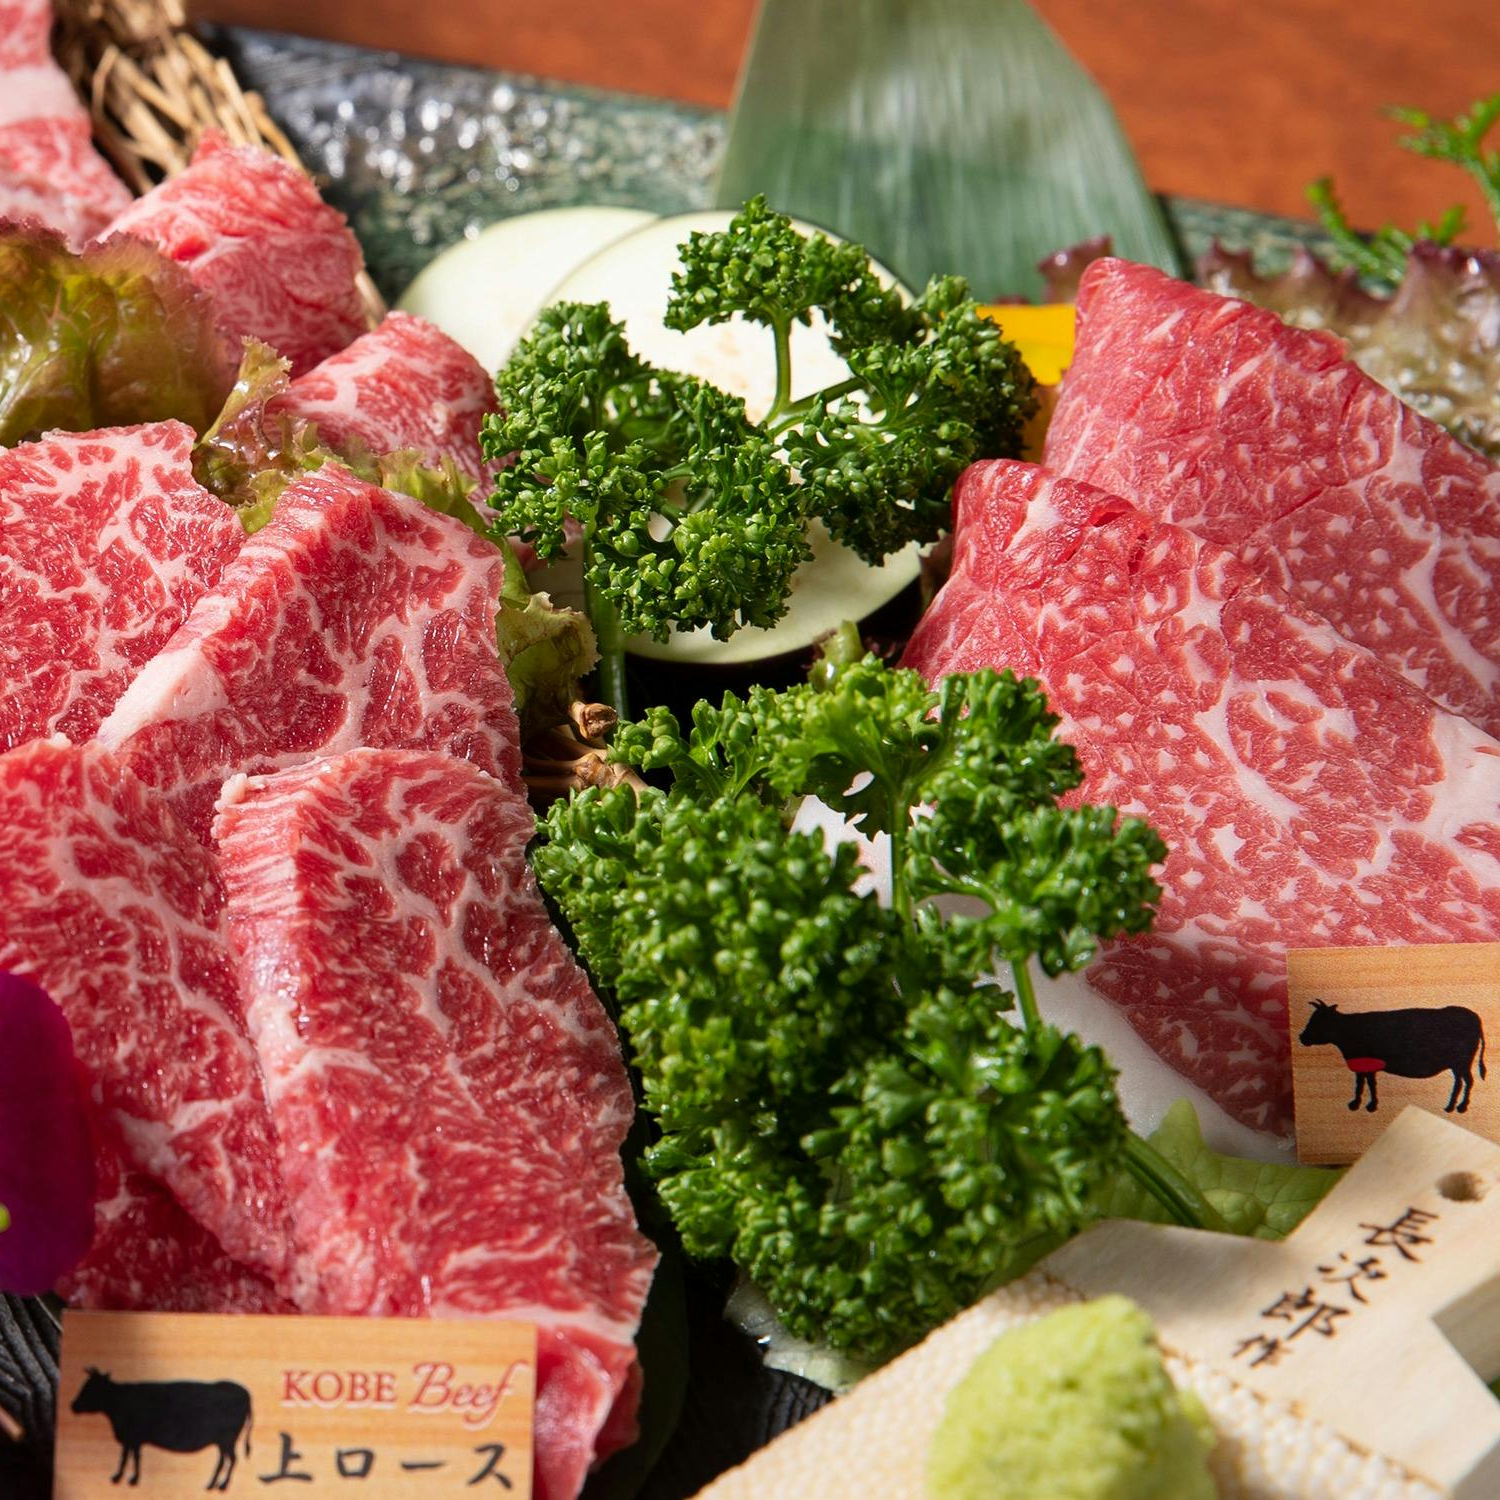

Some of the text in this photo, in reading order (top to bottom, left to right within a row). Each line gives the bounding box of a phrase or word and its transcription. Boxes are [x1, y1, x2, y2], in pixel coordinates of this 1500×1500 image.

[1232, 1206, 1441, 1369] 長次郎作
[280, 1360, 529, 1426] KOBE Beef
[258, 1431, 515, 1491] 上ロース
